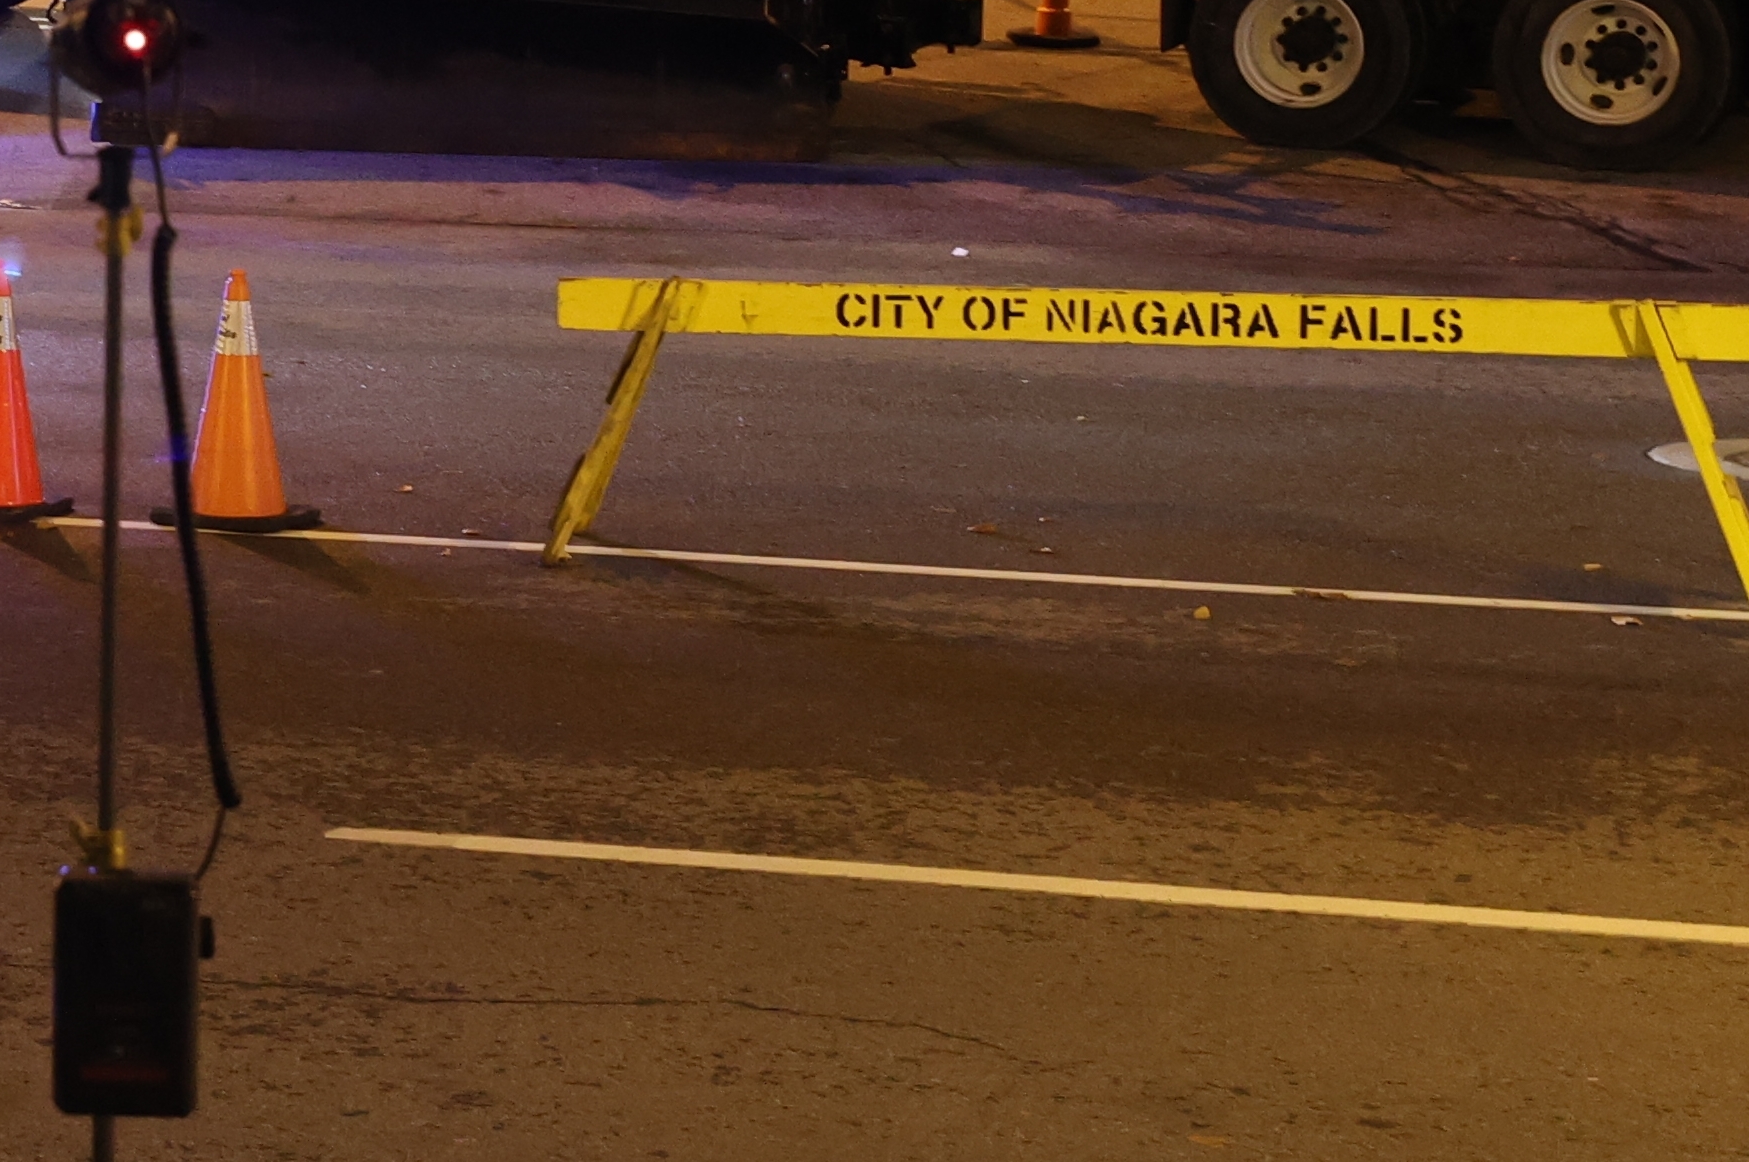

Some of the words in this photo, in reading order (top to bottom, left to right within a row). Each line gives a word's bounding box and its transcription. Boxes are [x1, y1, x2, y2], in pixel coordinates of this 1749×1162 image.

[836, 293, 944, 330] CITY
[962, 295, 1028, 332] OF
[1046, 298, 1280, 339] NIAGARA
[1299, 304, 1464, 343] FALLS
